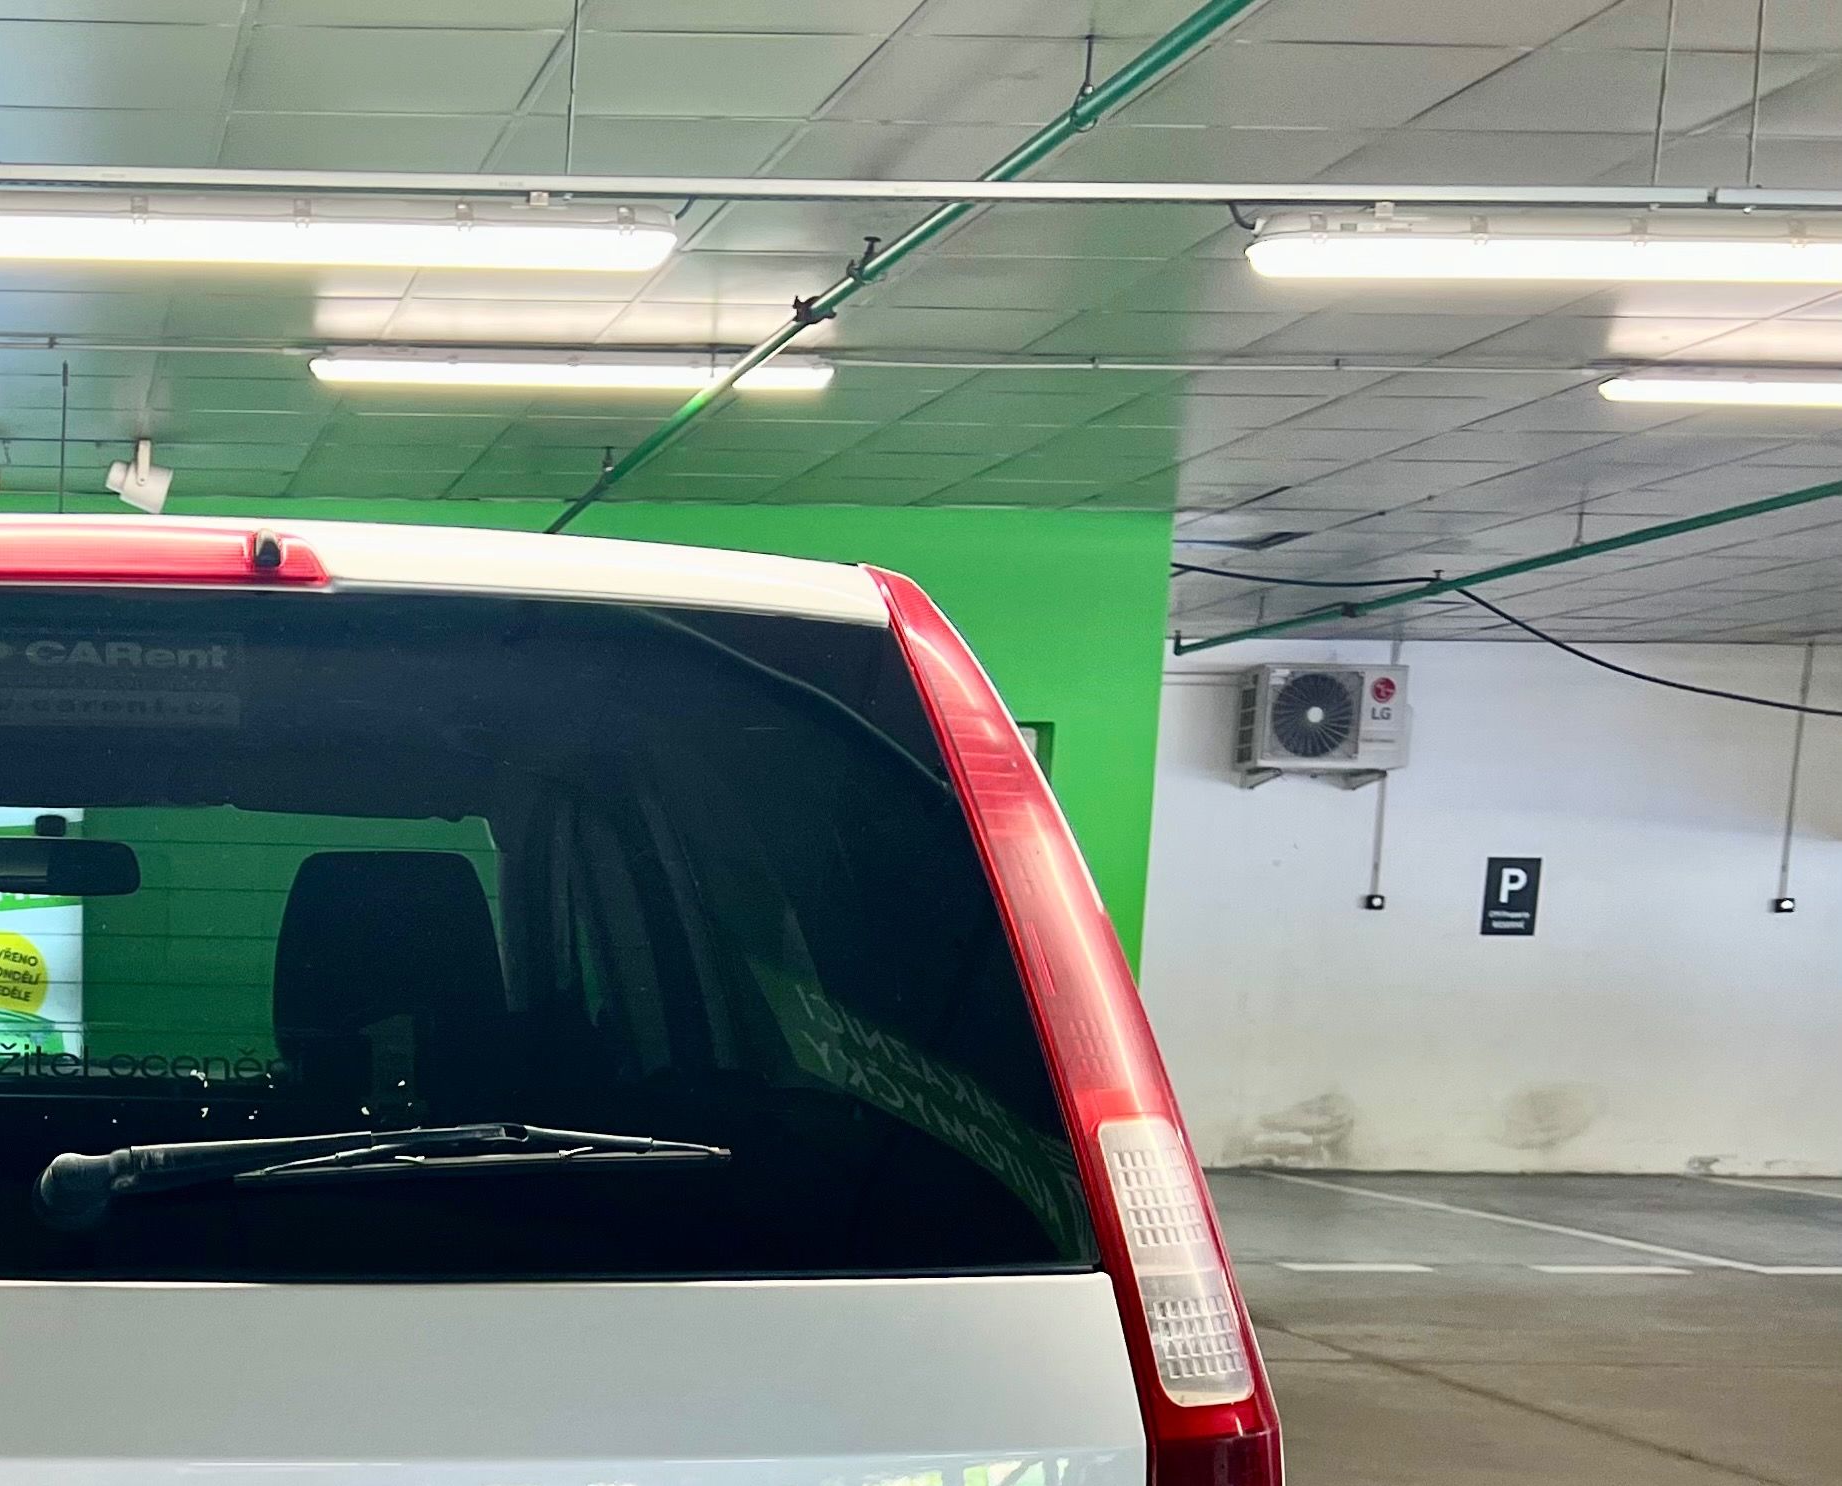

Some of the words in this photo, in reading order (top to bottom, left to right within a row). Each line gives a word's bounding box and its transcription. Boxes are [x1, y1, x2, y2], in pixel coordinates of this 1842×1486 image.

[25, 640, 228, 668] CARent
[1371, 706, 1391, 720] LG
[1499, 867, 1528, 904] P
